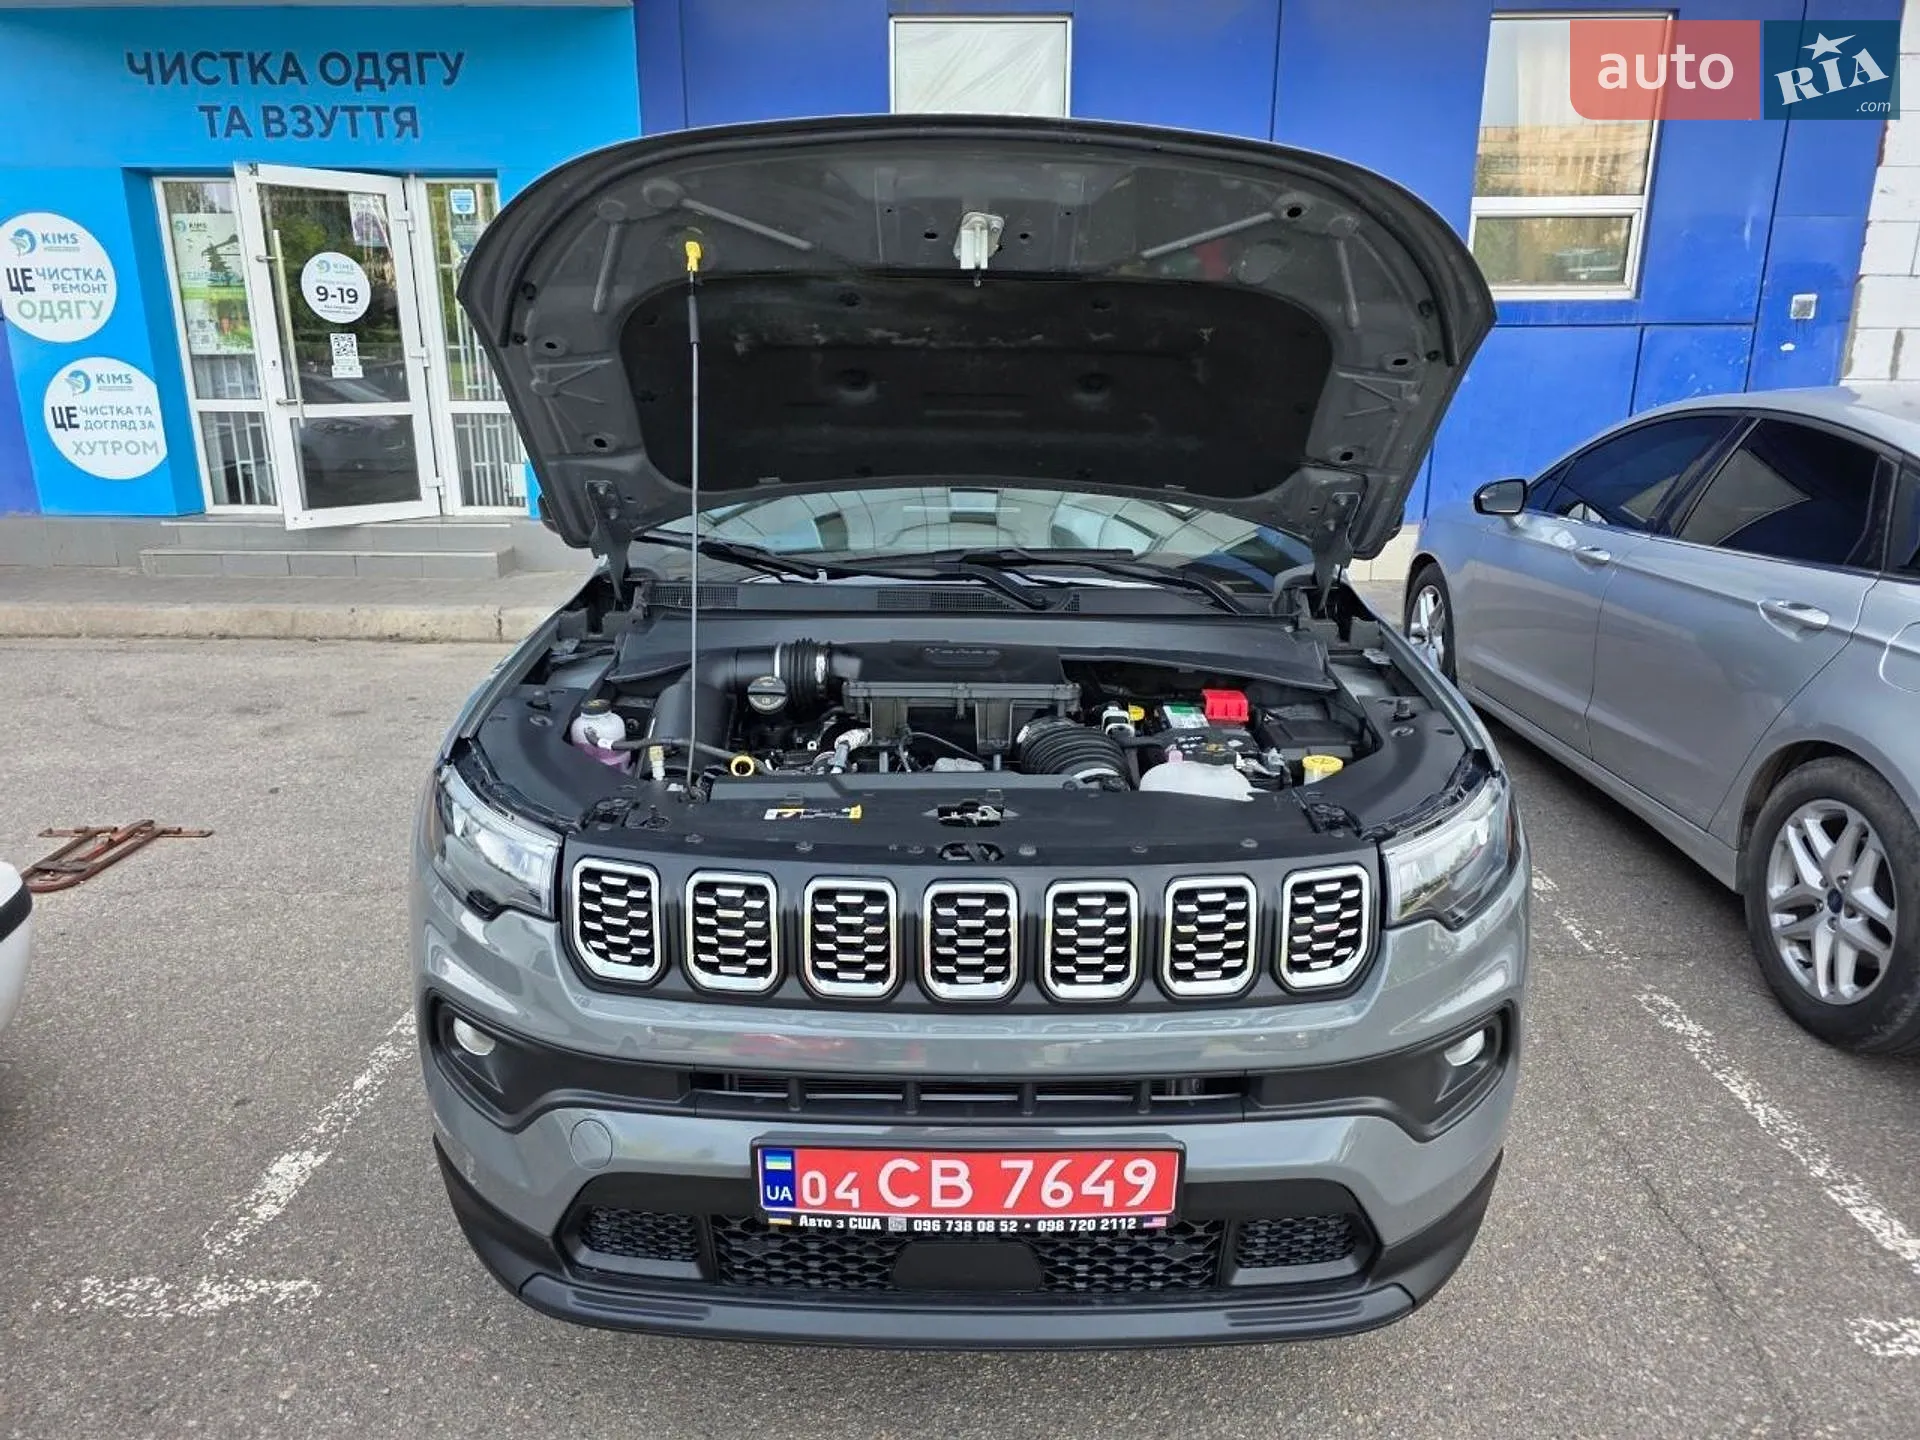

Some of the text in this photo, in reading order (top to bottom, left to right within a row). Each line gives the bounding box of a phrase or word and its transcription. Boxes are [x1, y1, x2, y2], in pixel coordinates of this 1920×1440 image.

[126, 50, 466, 92] ЧИСТКА ОДЯГУ
[198, 104, 420, 139] ТА ВЗУТТЯ
[40, 232, 79, 245] KIMS
[5, 267, 107, 295] ЦЕ ЧИСТКА
[51, 283, 108, 294] РЕМОНТ
[315, 285, 359, 305] 9-19
[17, 300, 104, 323] ОДЯГУ
[95, 373, 133, 385] KIMS
[50, 405, 153, 431] ЦЕ ЧИСТКА ТА
[83, 419, 156, 431] ДОГЛЯД ЗА
[72, 440, 160, 456] ХУТРОМ
[801, 1170, 860, 1208] 04
[1000, 1158, 1157, 1209] 7649
[766, 1186, 793, 1201] UA
[799, 1215, 832, 1228] Авто
[849, 1217, 882, 1230] США
[913, 1219, 941, 1232] 096
[945, 1220, 972, 1232] 738
[976, 1220, 996, 1233] 08
[1000, 1220, 1018, 1232] 52
[1037, 1219, 1065, 1232] 098
[1069, 1219, 1096, 1232] 720
[1100, 1218, 1136, 1231] 2112
